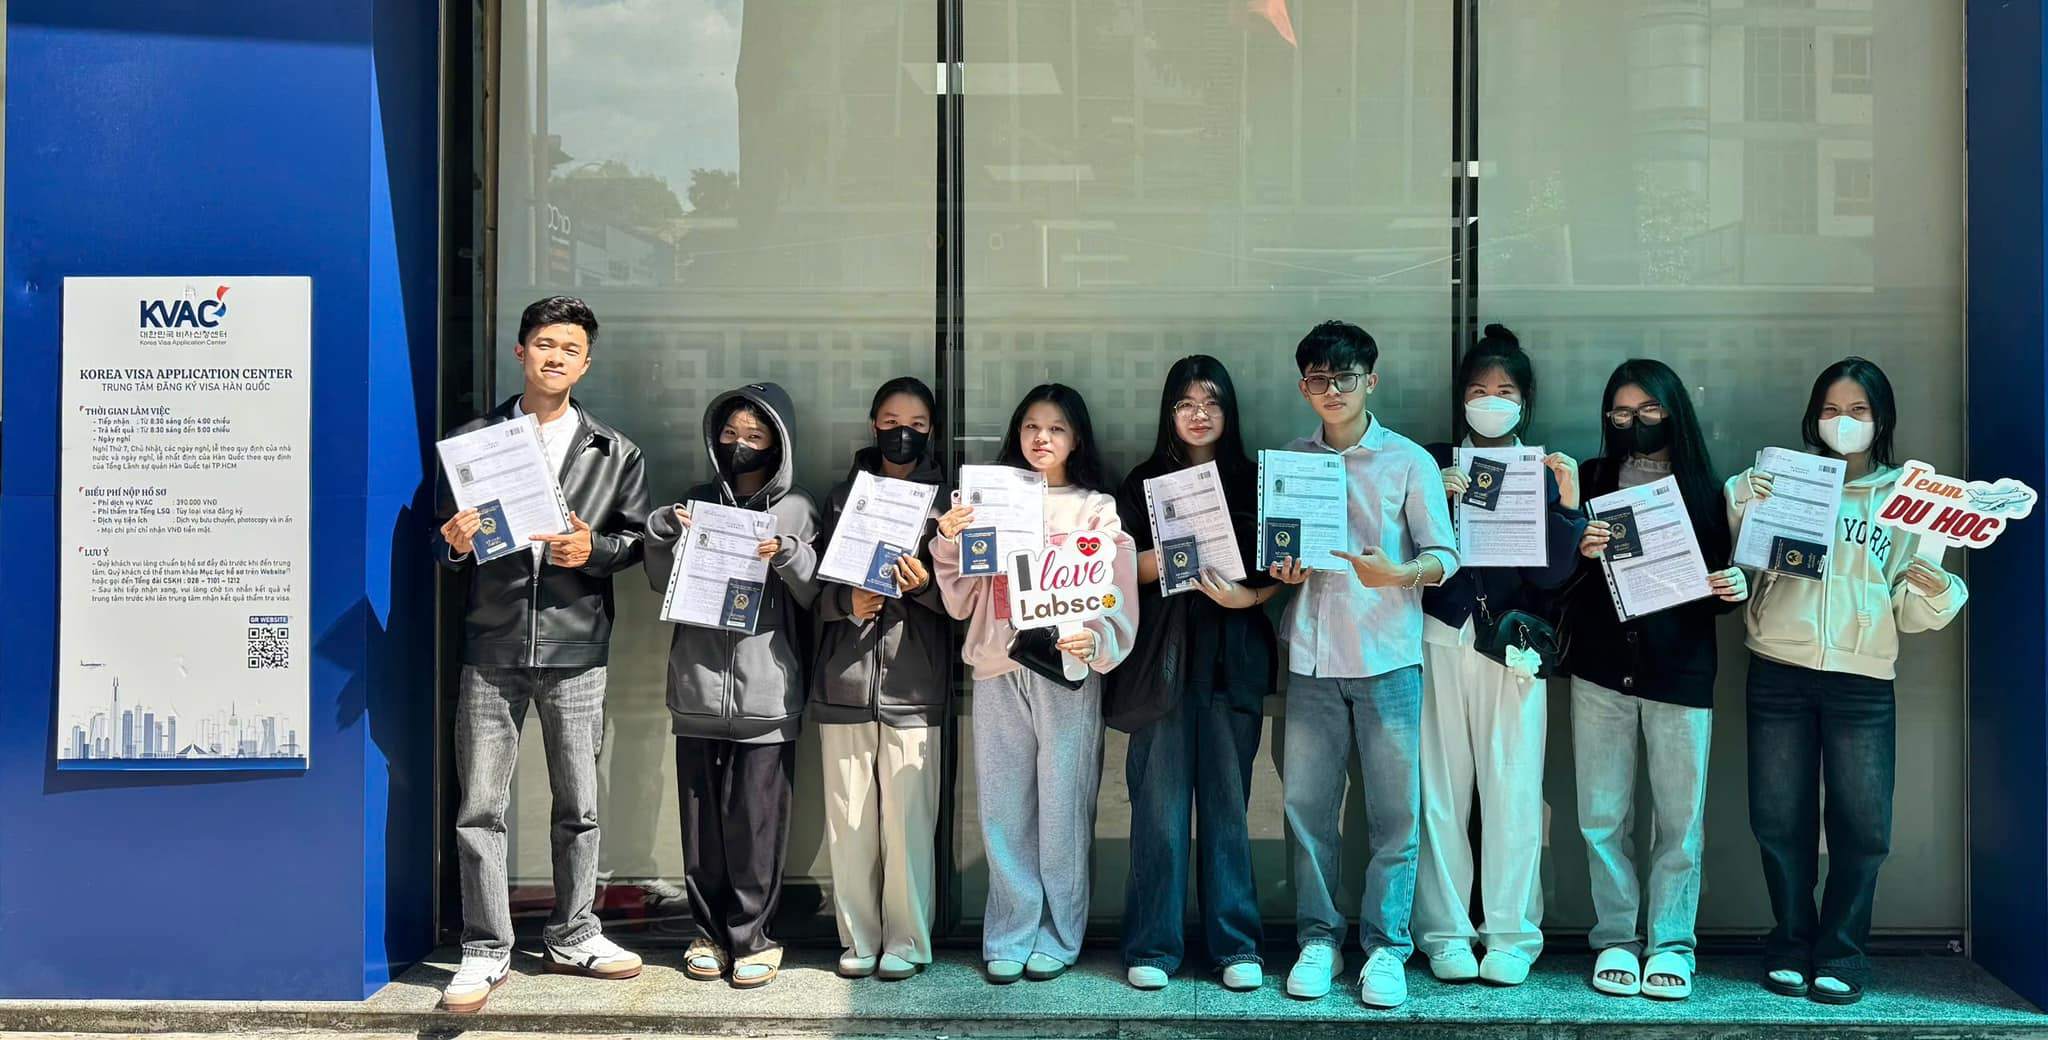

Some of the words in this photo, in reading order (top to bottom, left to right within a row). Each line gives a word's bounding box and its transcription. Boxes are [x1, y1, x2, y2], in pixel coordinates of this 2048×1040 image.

[140, 300, 221, 328] KVAC
[81, 369, 122, 379] KOREA
[125, 369, 153, 379] VISA
[157, 369, 239, 379] APPLICATION
[243, 369, 292, 379] CENTER
[102, 383, 132, 391] TRUNG
[135, 381, 153, 391] TÂM
[157, 381, 182, 391] ĐĂNG
[185, 381, 197, 391] KÝ
[199, 383, 221, 391] VISA
[223, 381, 242, 391] HÀN
[245, 381, 270, 391] QUỐC
[86, 406, 106, 415] THỜI
[131, 406, 149, 415] LÀM
[151, 406, 170, 416] VIỆC
[85, 487, 104, 496] BIỂU
[107, 487, 121, 496] PHÍ
[123, 487, 140, 497] NỘP
[142, 487, 153, 496] HỒ
[1902, 466, 1964, 500] Team
[1881, 494, 1934, 524] DU
[1929, 506, 2000, 542] HỌC
[1844, 518, 1892, 562] YORK
[104, 548, 109, 556] Ý
[1016, 554, 1032, 592] I
[1040, 550, 1106, 591] love
